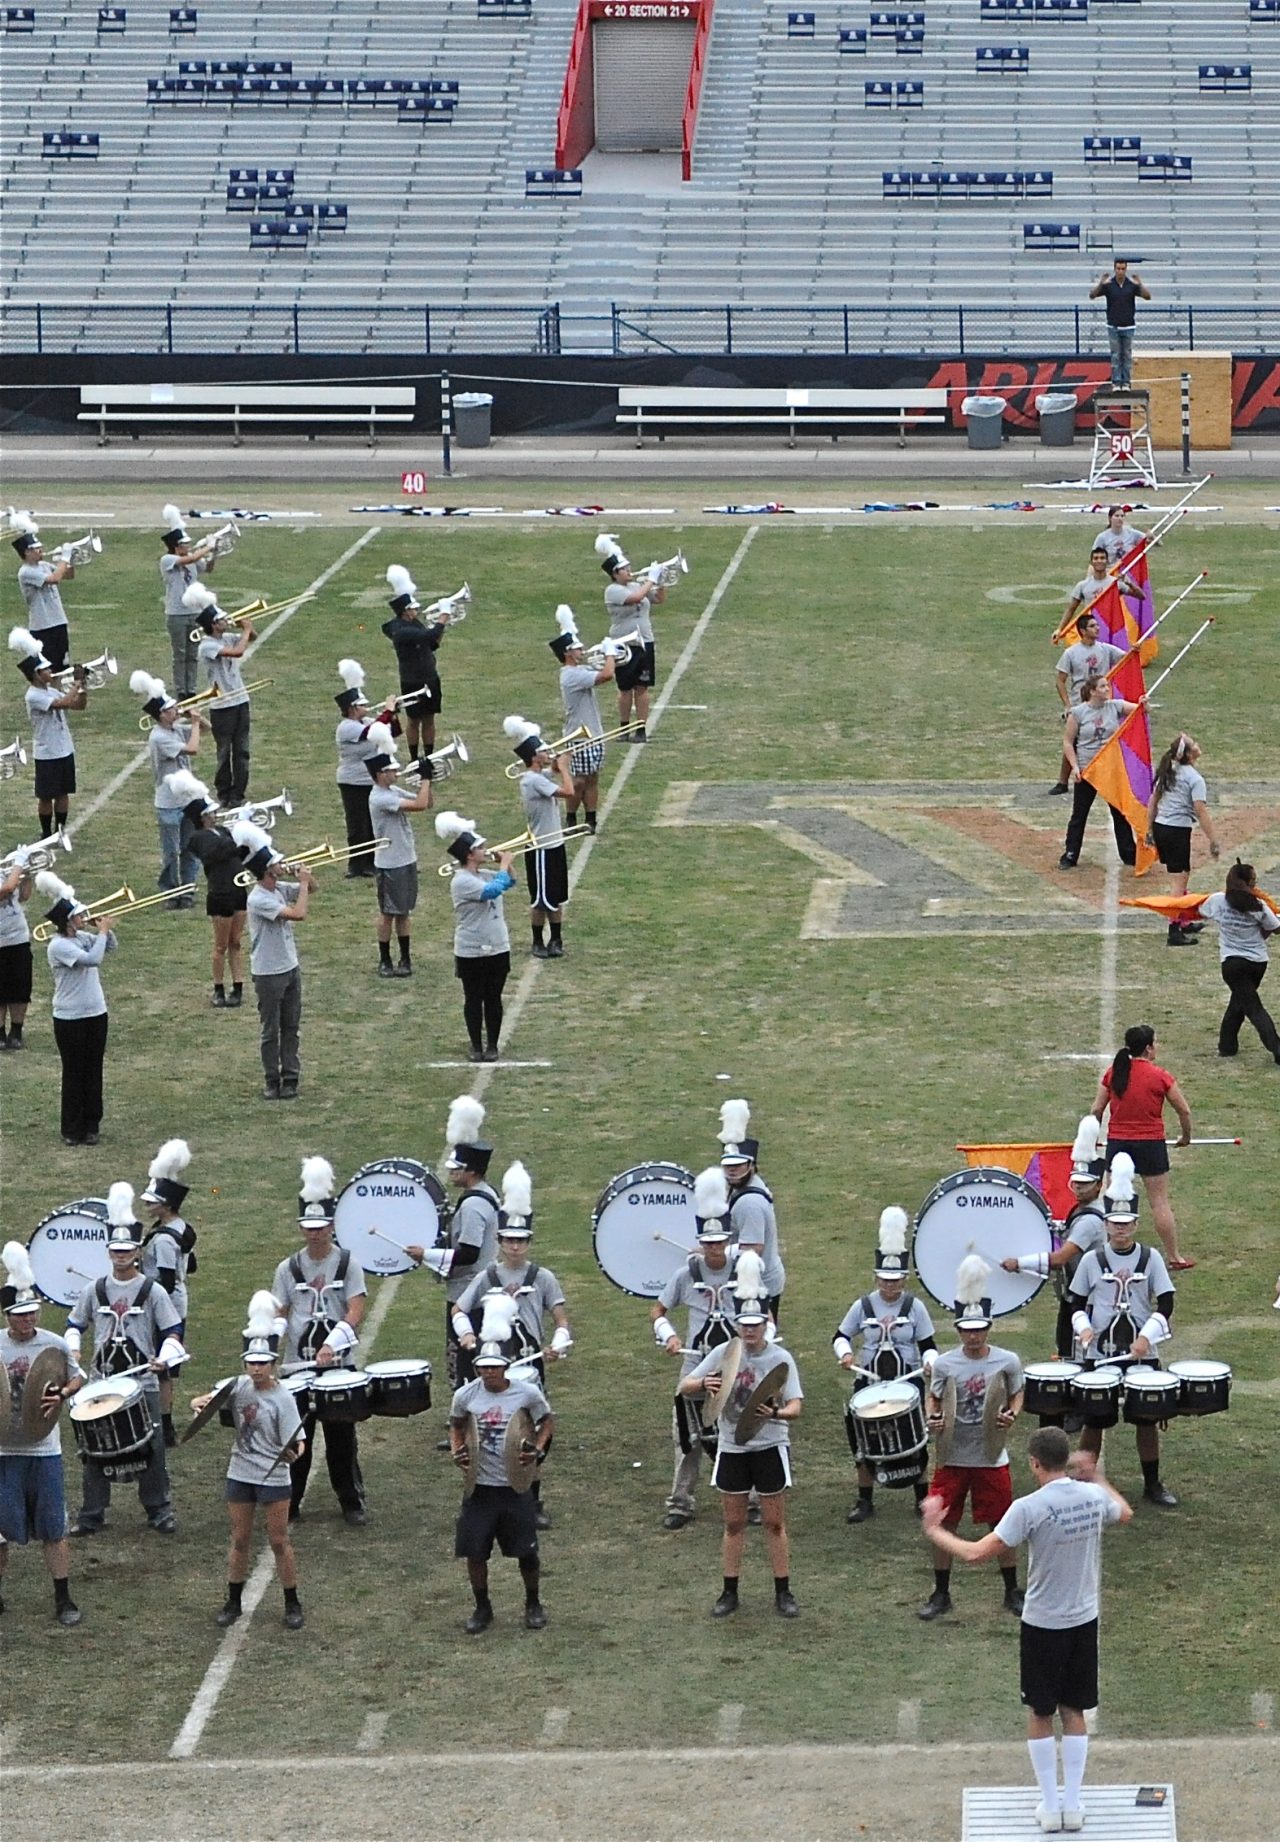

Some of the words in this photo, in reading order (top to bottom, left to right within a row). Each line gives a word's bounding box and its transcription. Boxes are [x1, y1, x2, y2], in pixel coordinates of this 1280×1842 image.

[614, 5, 626, 16] 20
[629, 5, 668, 17] SECTION
[670, 5, 680, 17] 21
[1111, 435, 1132, 453] 50
[403, 473, 424, 493] 40
[370, 1185, 416, 1198] YAMAHA
[642, 1193, 687, 1206] YAMAHA
[970, 1195, 1015, 1209] YAMAHA
[60, 1228, 106, 1241] YAMAHA
[887, 1464, 921, 1481] YAMAHA
